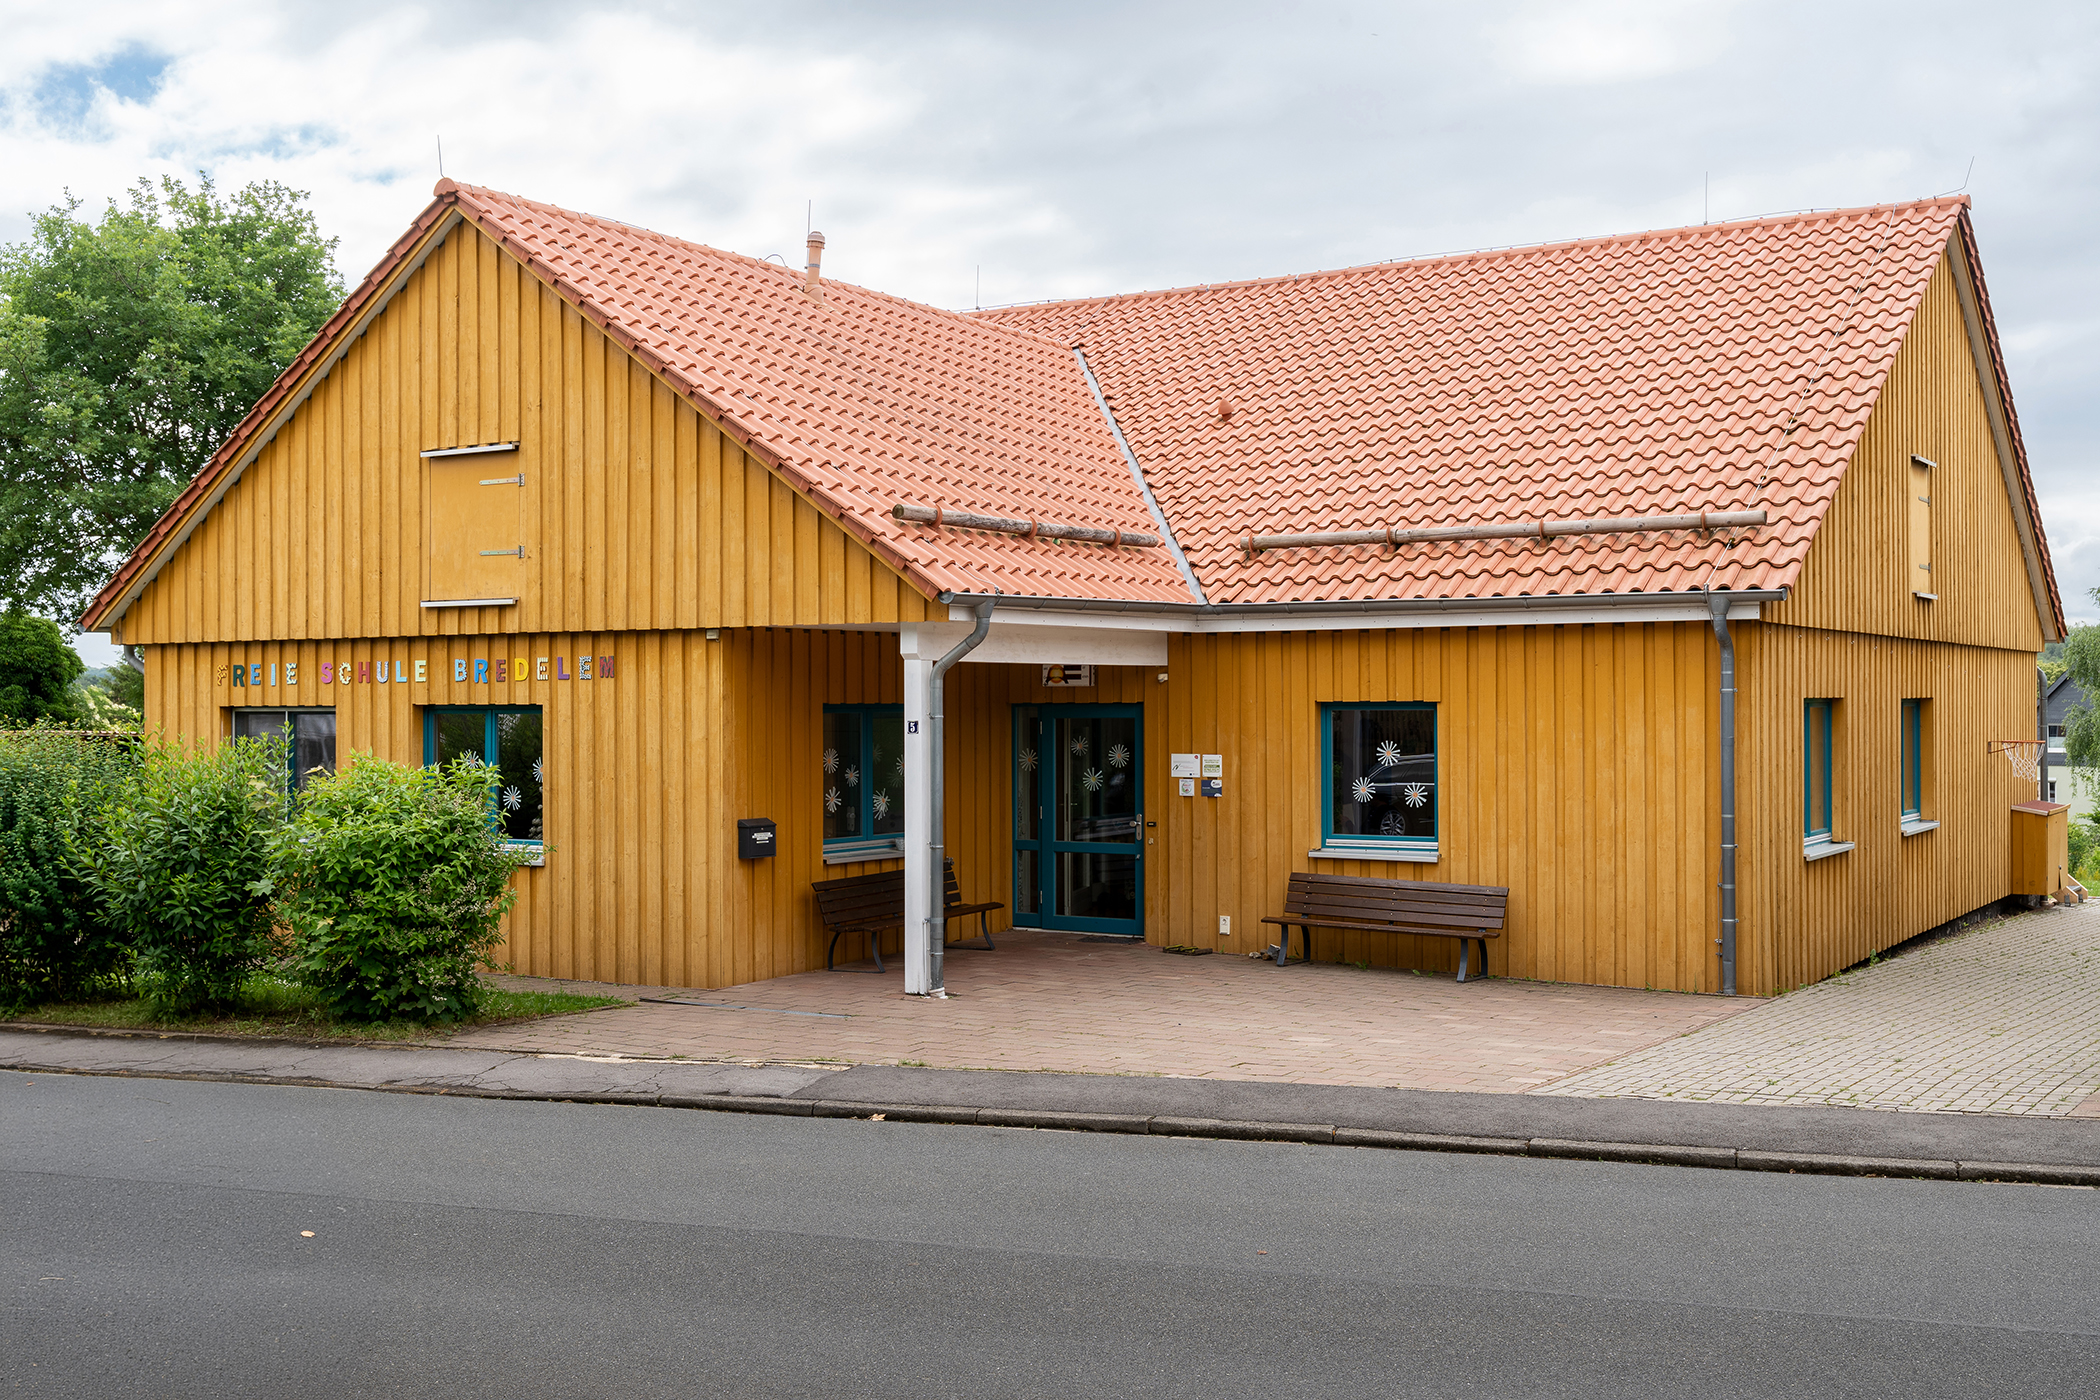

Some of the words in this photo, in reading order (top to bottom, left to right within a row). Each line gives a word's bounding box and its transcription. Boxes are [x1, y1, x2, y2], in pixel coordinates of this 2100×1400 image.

[216, 663, 298, 687] FREIE
[320, 660, 427, 685] SCHULE
[454, 656, 615, 684] BREDELEM
